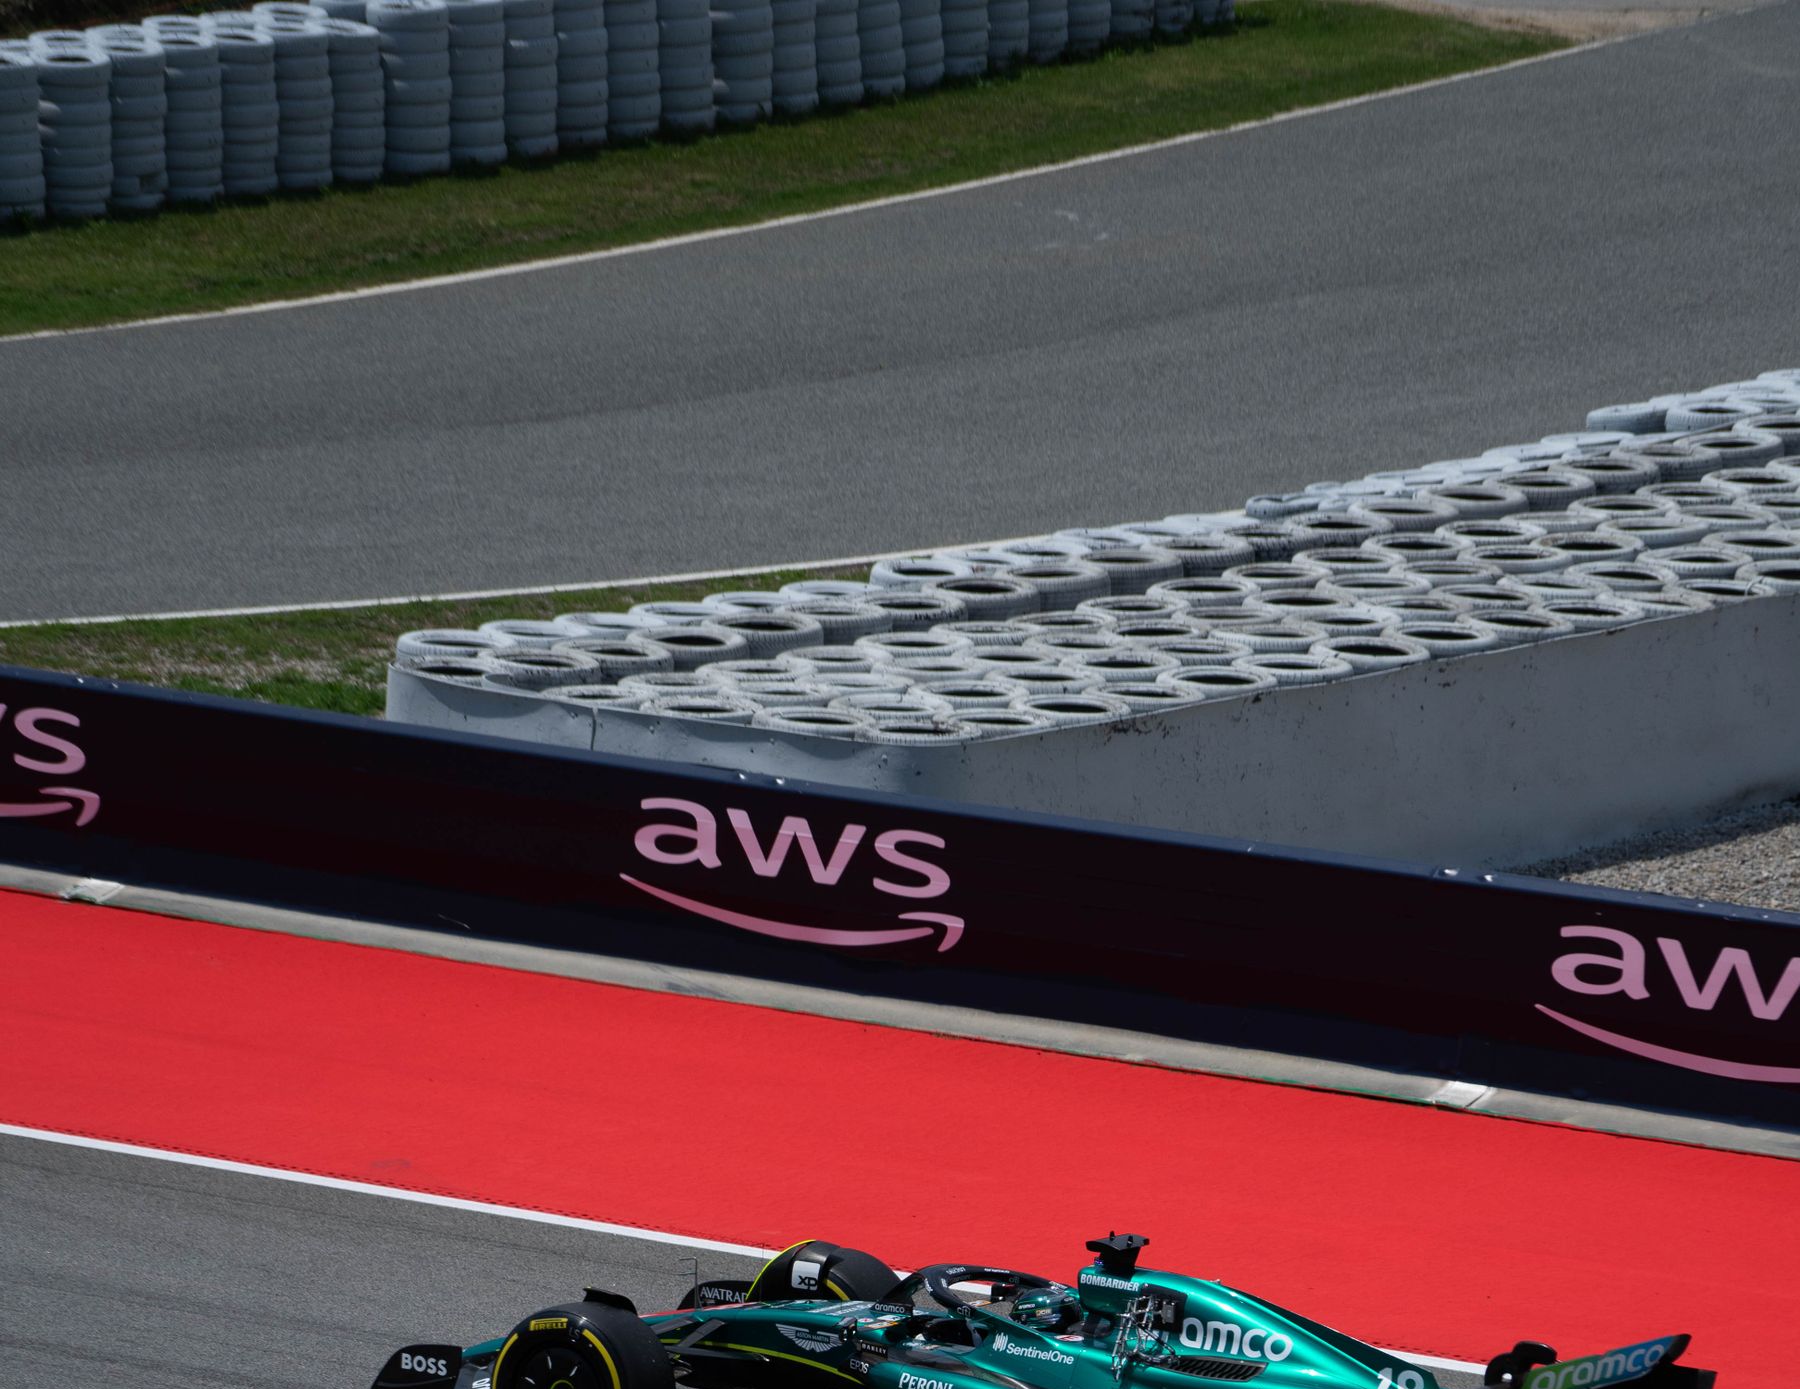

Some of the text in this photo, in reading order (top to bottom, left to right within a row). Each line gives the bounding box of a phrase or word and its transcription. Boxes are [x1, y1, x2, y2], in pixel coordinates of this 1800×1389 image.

[633, 797, 951, 898] aws
[1080, 1273, 1140, 1292] BOMBARDIER
[875, 1303, 905, 1314] aramco
[956, 1306, 972, 1317] citi
[529, 1318, 569, 1331] PIRELLI
[796, 1331, 812, 1339] ASTON
[1137, 1317, 1293, 1362] amco
[1007, 1342, 1074, 1365] SentinelOne
[401, 1353, 447, 1376] BOSS
